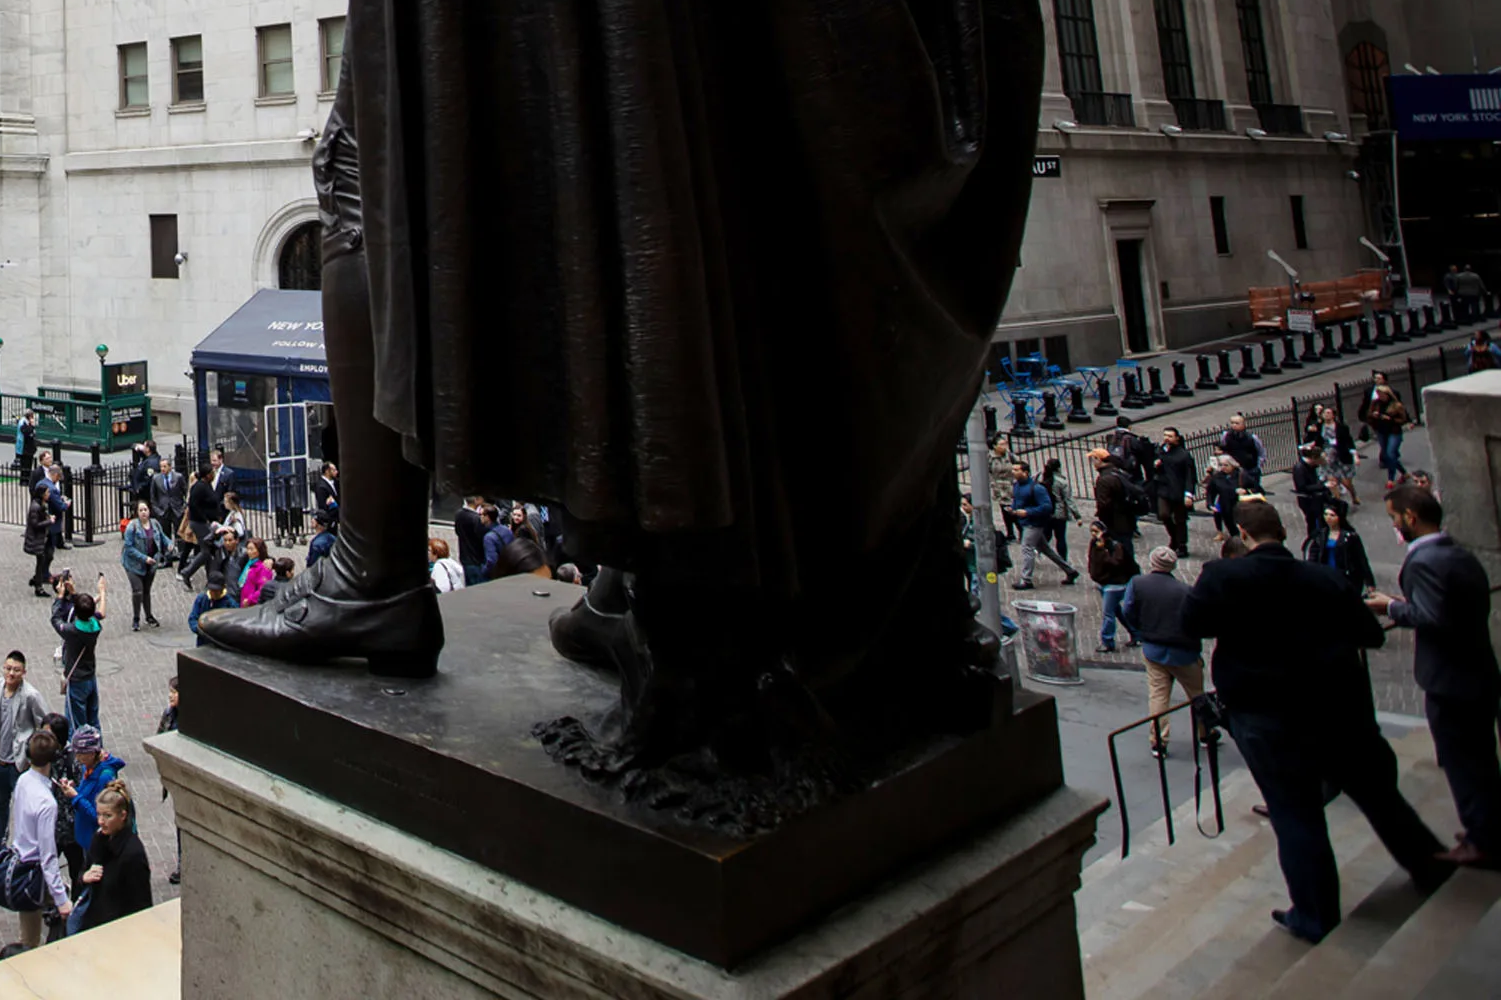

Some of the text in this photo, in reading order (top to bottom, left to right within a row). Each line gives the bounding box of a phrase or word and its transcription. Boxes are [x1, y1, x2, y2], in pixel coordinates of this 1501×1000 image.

[1412, 113, 1438, 123] NEW
[1440, 112, 1470, 123] YORK
[267, 321, 303, 330] NEW
[271, 340, 317, 348] FOLLOW
[116, 374, 137, 386] Uber
